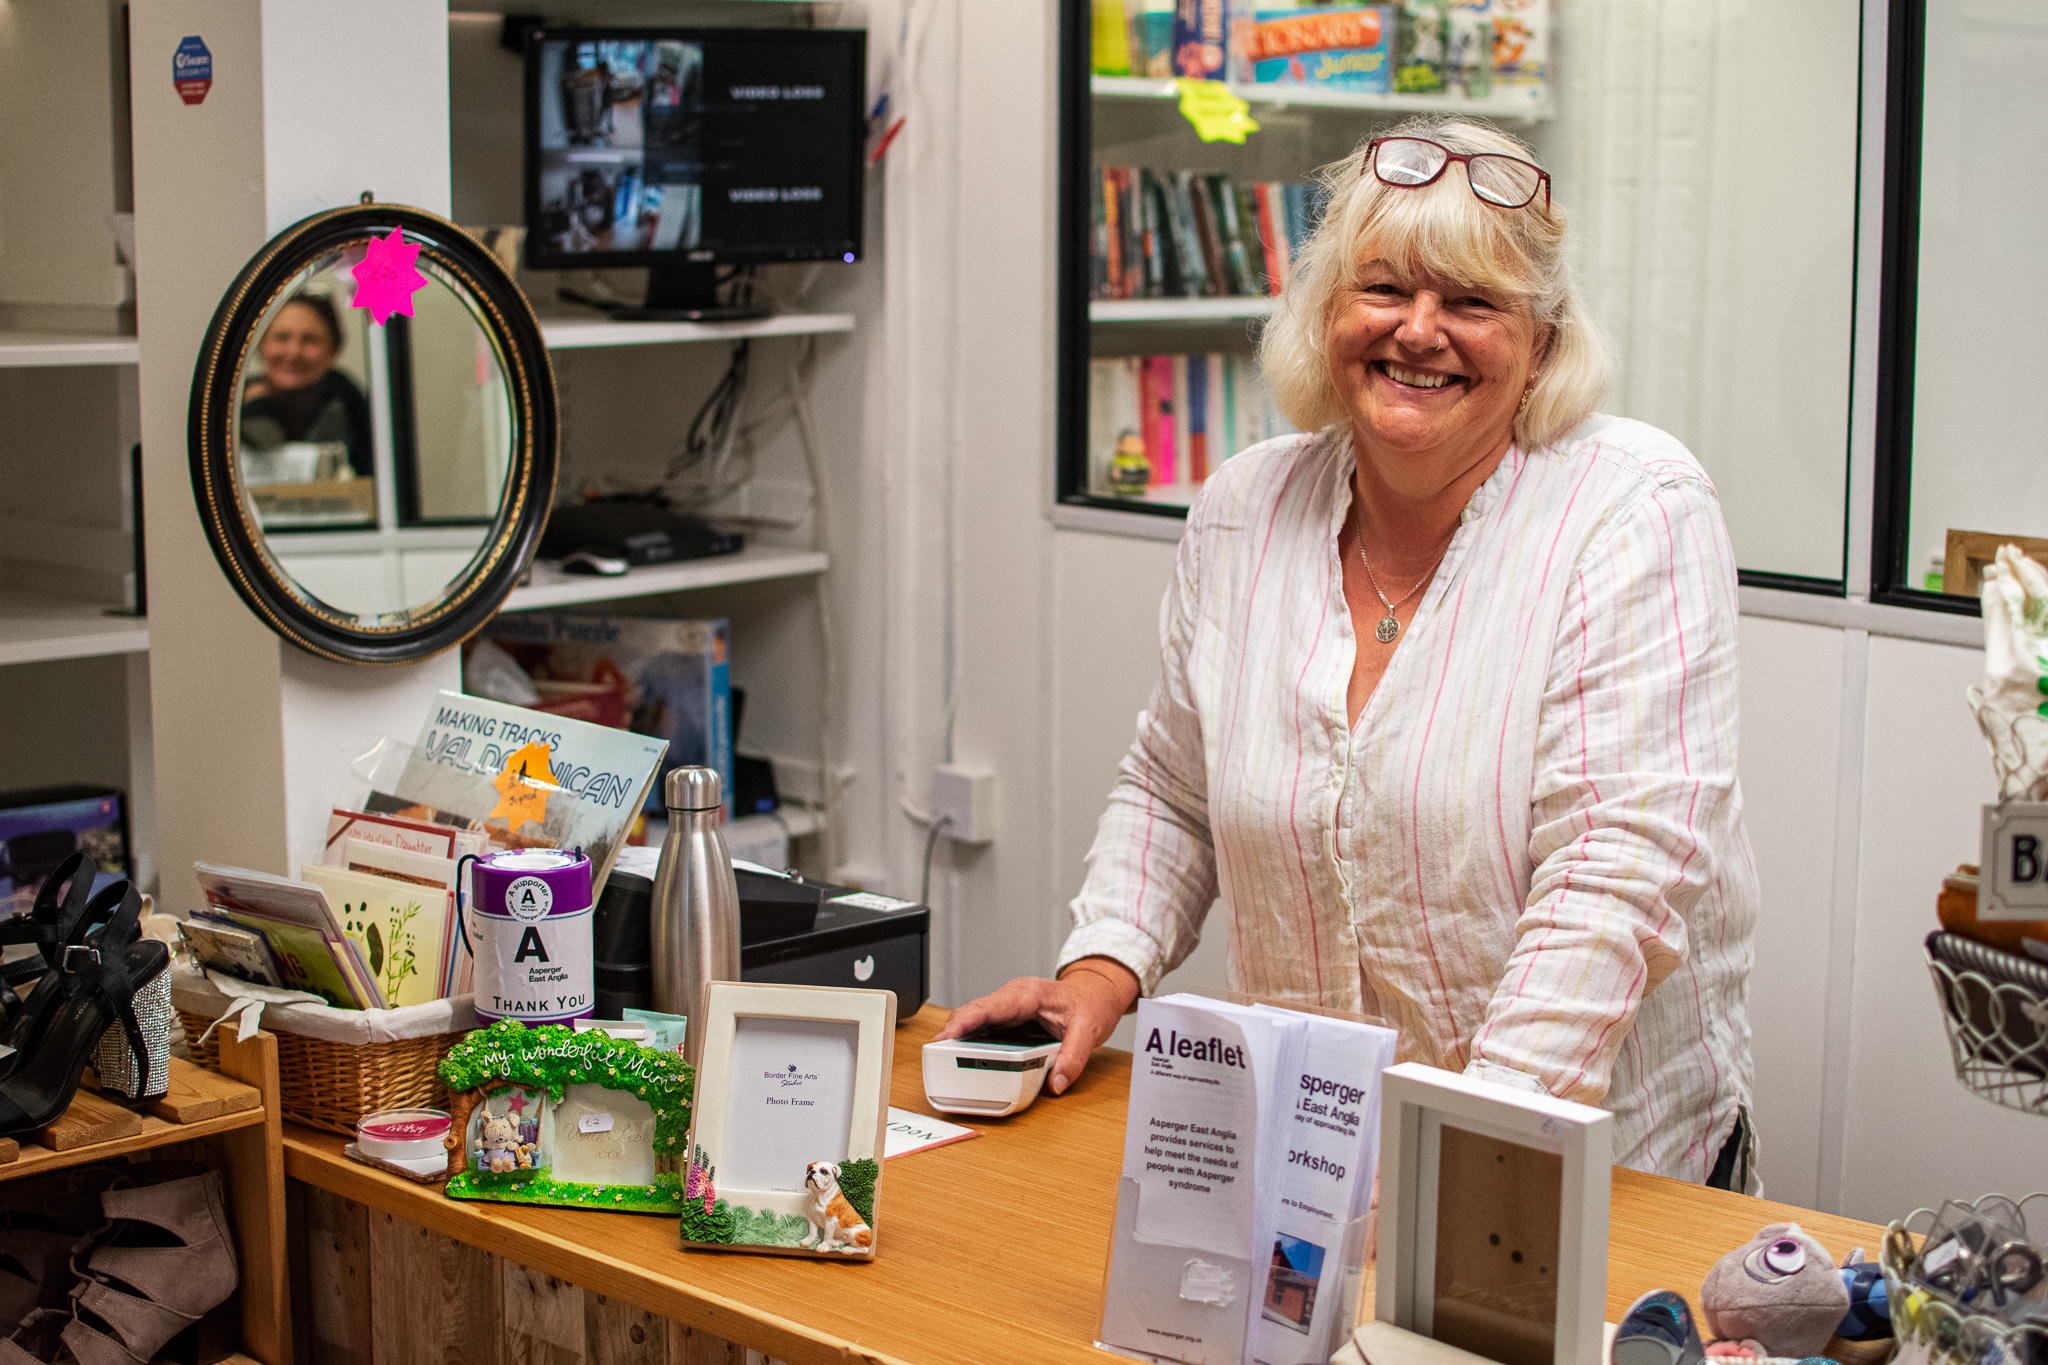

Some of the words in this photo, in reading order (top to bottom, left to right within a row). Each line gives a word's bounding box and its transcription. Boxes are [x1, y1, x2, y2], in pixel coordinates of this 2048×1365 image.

[435, 706, 497, 737] MAKING
[499, 721, 561, 753] TRACKS
[426, 729, 472, 772] VAL
[2011, 833, 2048, 884] B
[513, 880, 549, 897] supporter
[521, 888, 536, 904] A
[513, 926, 550, 963] A
[528, 966, 563, 975] Asperger
[528, 975, 546, 983] East
[547, 973, 569, 982] Anglia
[493, 995, 549, 1012] THANK
[556, 993, 586, 1010] YOU
[1145, 1027, 1164, 1054] A
[1169, 1029, 1246, 1070] leaflet
[484, 1050, 514, 1077] My
[623, 1053, 675, 1093] Mum
[764, 1072, 787, 1080] Border
[788, 1072, 803, 1080] Fine
[766, 1096, 789, 1106] Photo
[791, 1097, 815, 1107] Frame
[1302, 1097, 1328, 1116] East
[1330, 1106, 1360, 1126] Anglia
[1149, 1117, 1188, 1132] Asperger
[1190, 1123, 1209, 1135] East
[1210, 1127, 1237, 1140] Anglia
[1313, 1119, 1347, 1136] approaching
[1348, 1128, 1356, 1137] life
[1150, 1132, 1187, 1146] provides
[1189, 1138, 1224, 1152] services
[1226, 1145, 1234, 1154] to
[1144, 1145, 1163, 1158] help
[1164, 1149, 1185, 1160] meet
[1187, 1152, 1201, 1163] the
[1203, 1156, 1228, 1168] needs
[1229, 1160, 1239, 1169] of
[1146, 1161, 1175, 1173] people
[1177, 1165, 1195, 1176] with
[1196, 1168, 1235, 1183] Asperger
[1168, 1179, 1211, 1193] syndrome
